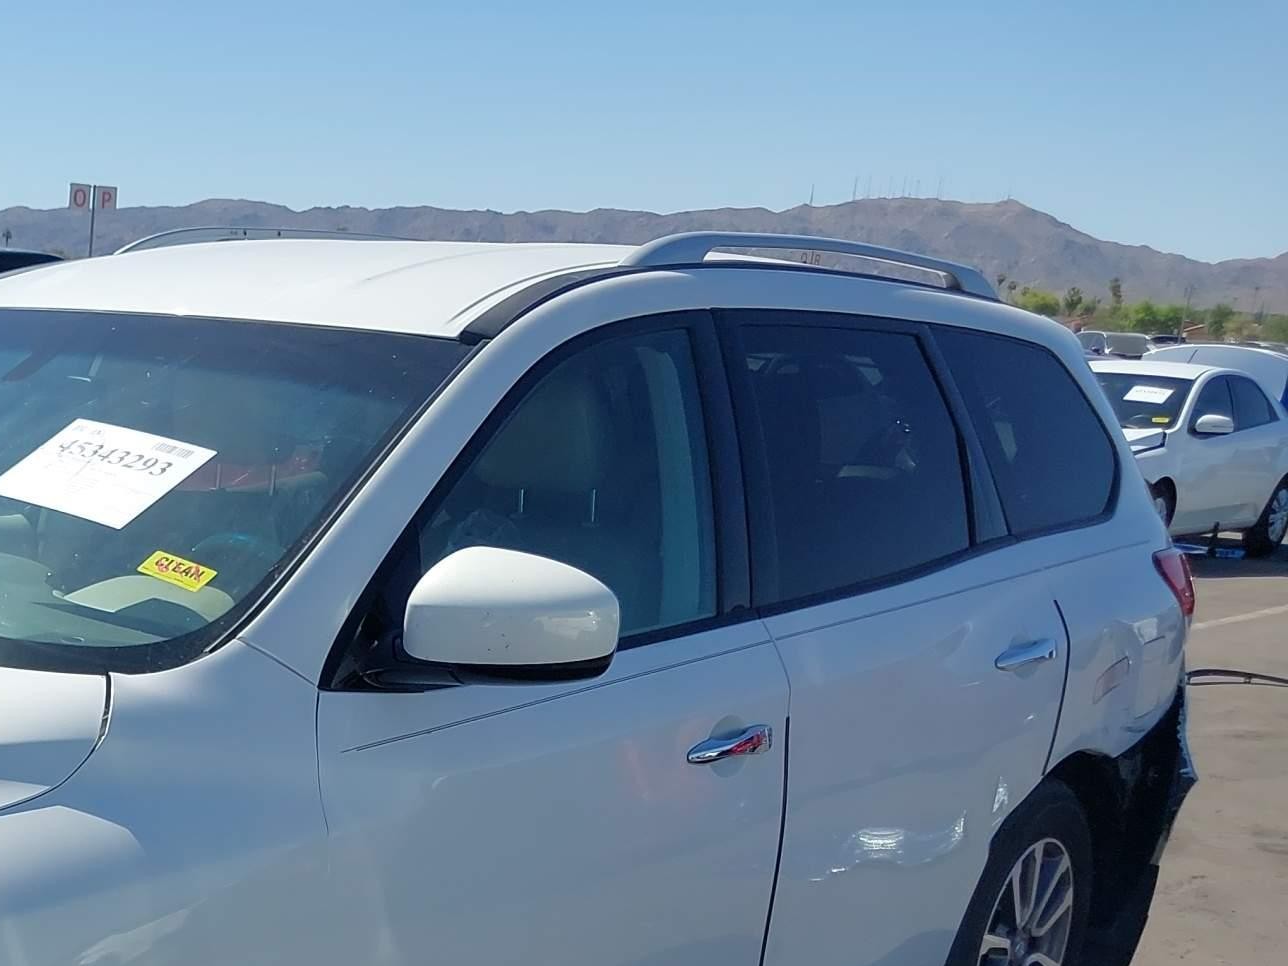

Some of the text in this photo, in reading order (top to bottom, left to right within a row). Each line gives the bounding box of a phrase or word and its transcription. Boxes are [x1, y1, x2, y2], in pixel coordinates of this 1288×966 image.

[73, 188, 112, 209] O P
[58, 439, 174, 477] 45343293
[154, 556, 206, 581] CLEAN
